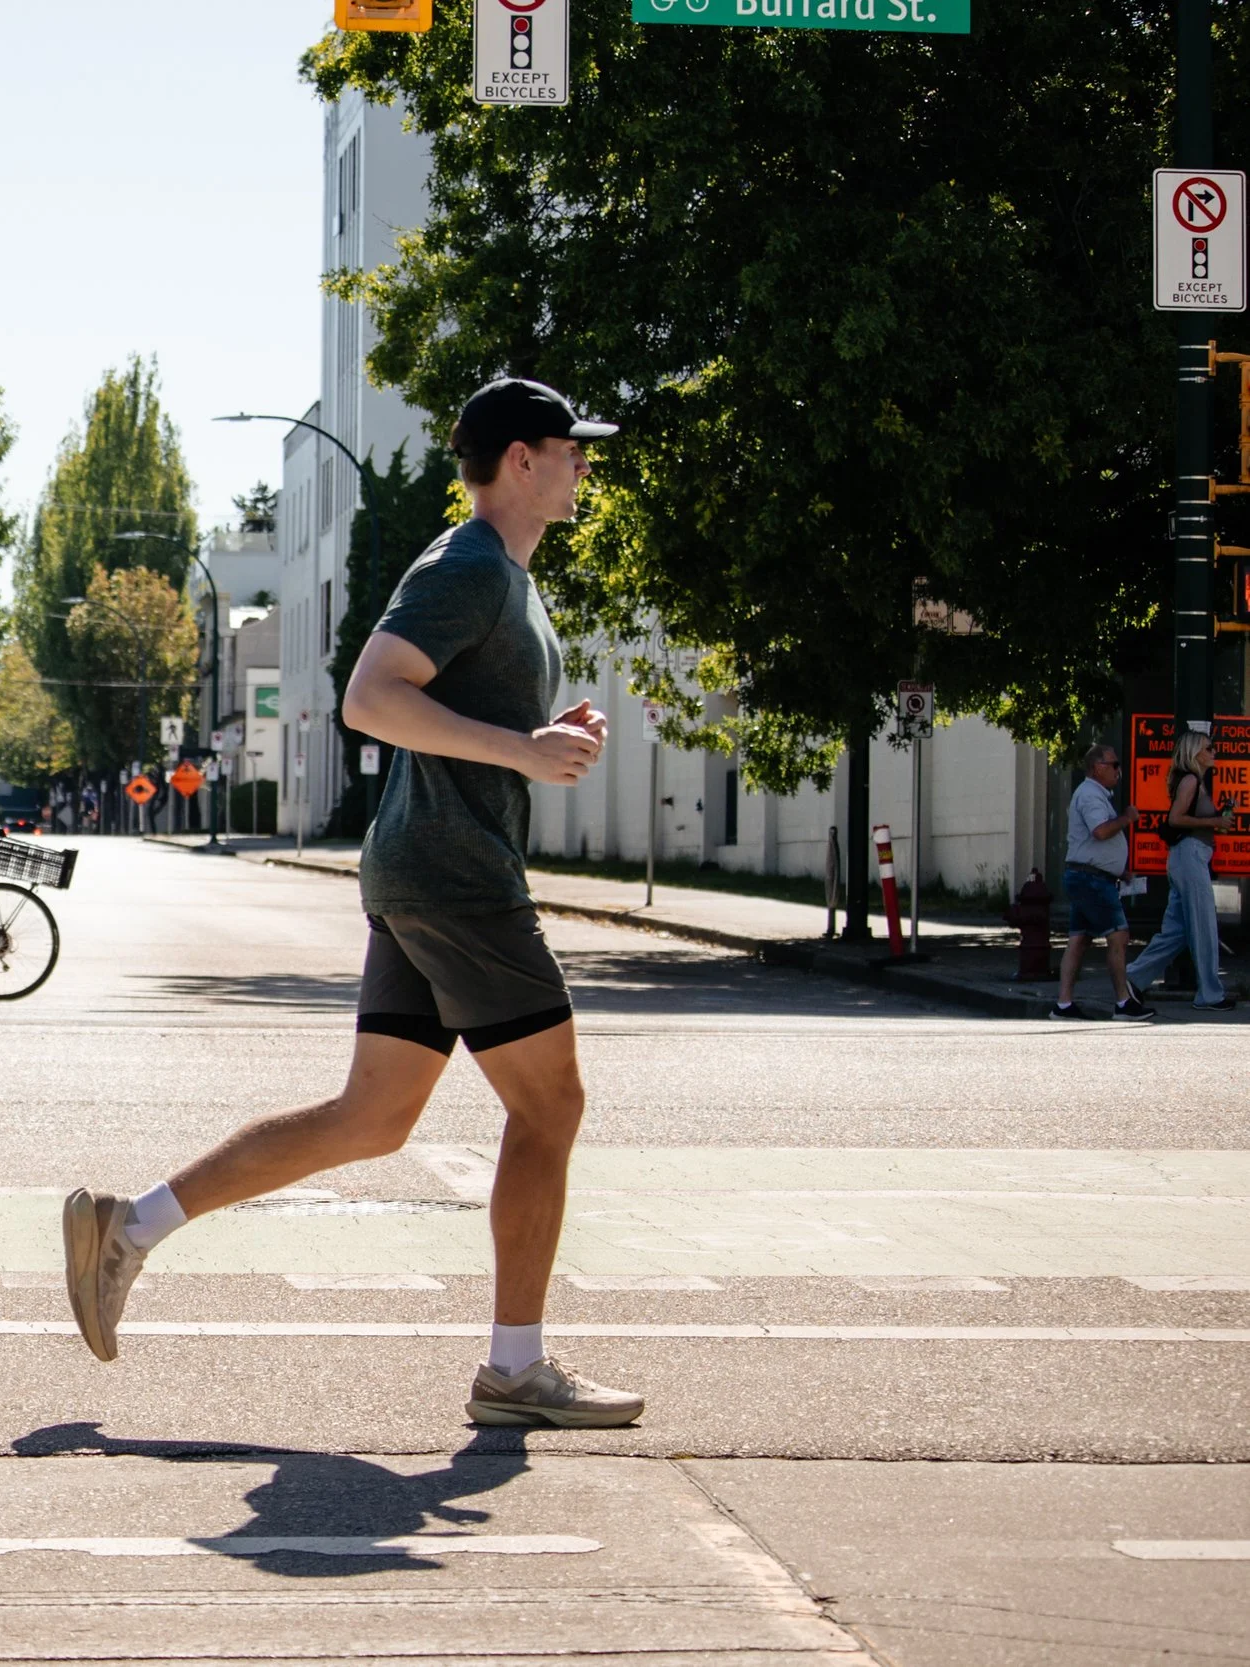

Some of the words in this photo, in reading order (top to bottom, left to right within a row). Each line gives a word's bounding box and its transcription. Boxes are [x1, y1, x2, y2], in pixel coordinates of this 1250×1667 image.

[887, 0, 937, 23] St.
[492, 71, 550, 84] EXCEPT
[485, 86, 557, 99] BICYCLES
[1178, 282, 1222, 292] EXCEPT
[1172, 293, 1228, 303] BICYCLES
[1140, 764, 1161, 782] 1ST
